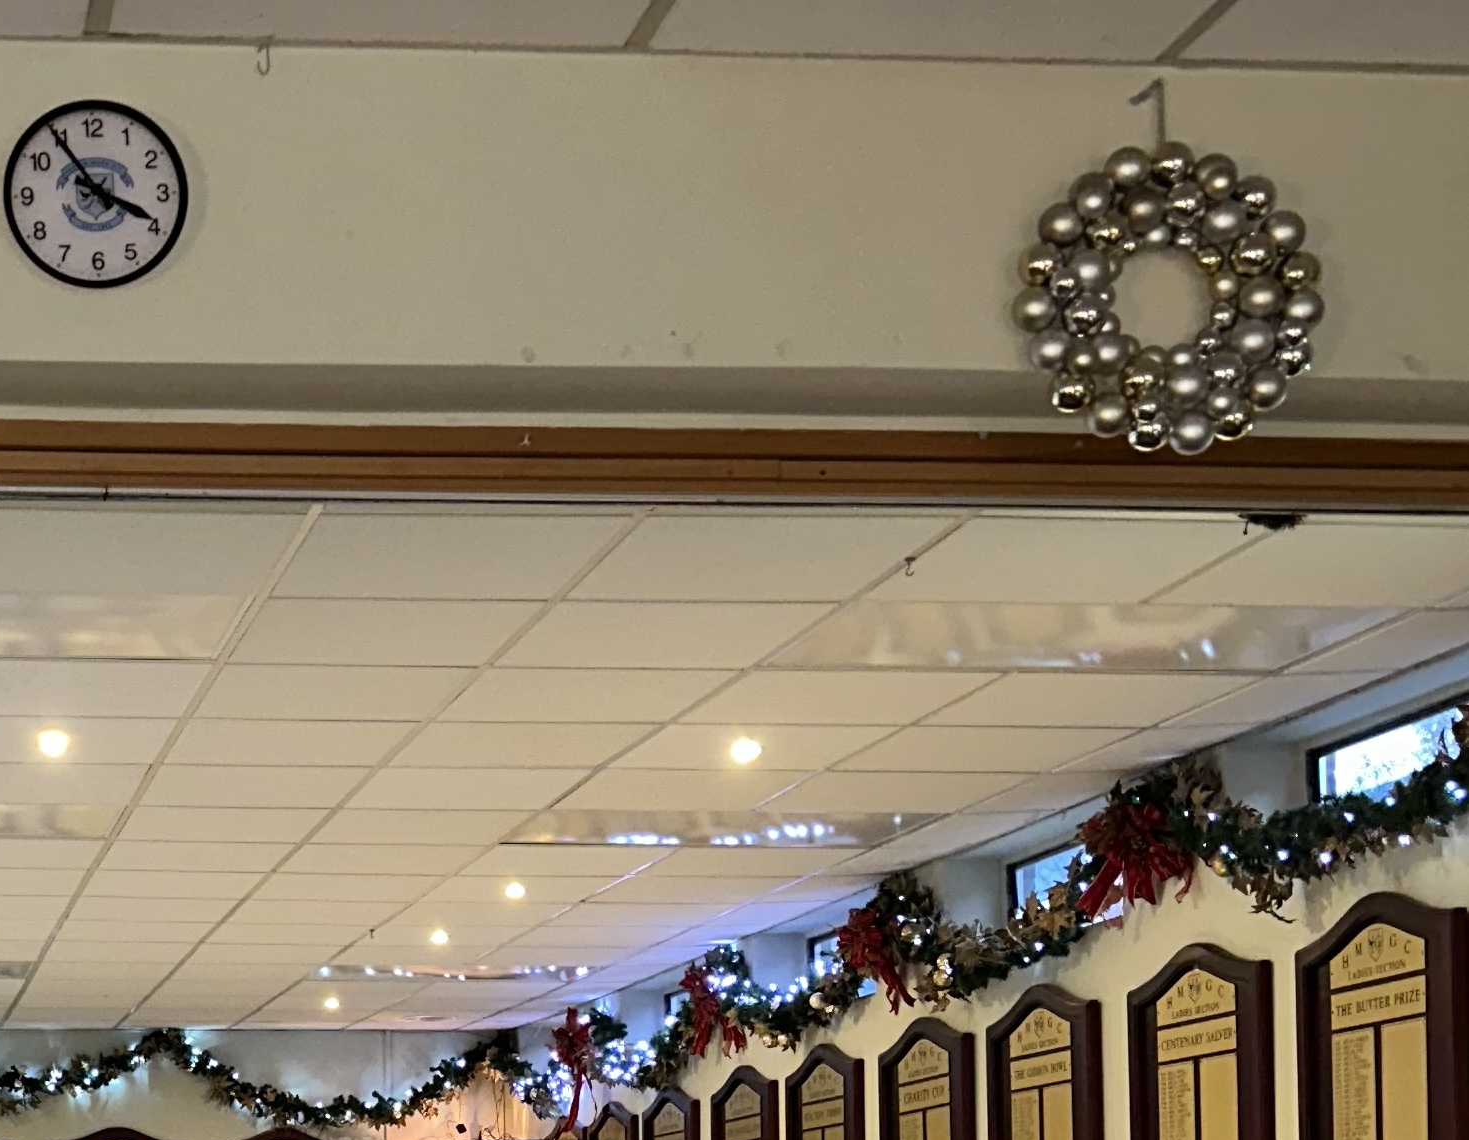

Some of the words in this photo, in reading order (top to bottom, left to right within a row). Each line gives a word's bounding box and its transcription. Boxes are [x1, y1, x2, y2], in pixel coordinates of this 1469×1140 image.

[82, 118, 104, 138] 12
[121, 128, 129, 145] 1
[53, 128, 68, 147] 11
[30, 152, 51, 171] 10
[145, 150, 157, 169] 2
[21, 187, 34, 205] 9
[156, 184, 169, 202] 3
[33, 221, 46, 240] 8
[148, 218, 160, 235] 4
[59, 244, 71, 262] 7
[125, 243, 137, 260] 5
[92, 252, 105, 270] 6
[1336, 1003, 1352, 1016] THE
[1356, 996, 1390, 1013] BUTTER
[1394, 989, 1420, 1005] PRIZE
[1161, 1033, 1203, 1051] CENTENARY
[1206, 1027, 1232, 1042] SALVER
[1051, 1061, 1067, 1073] BOWL
